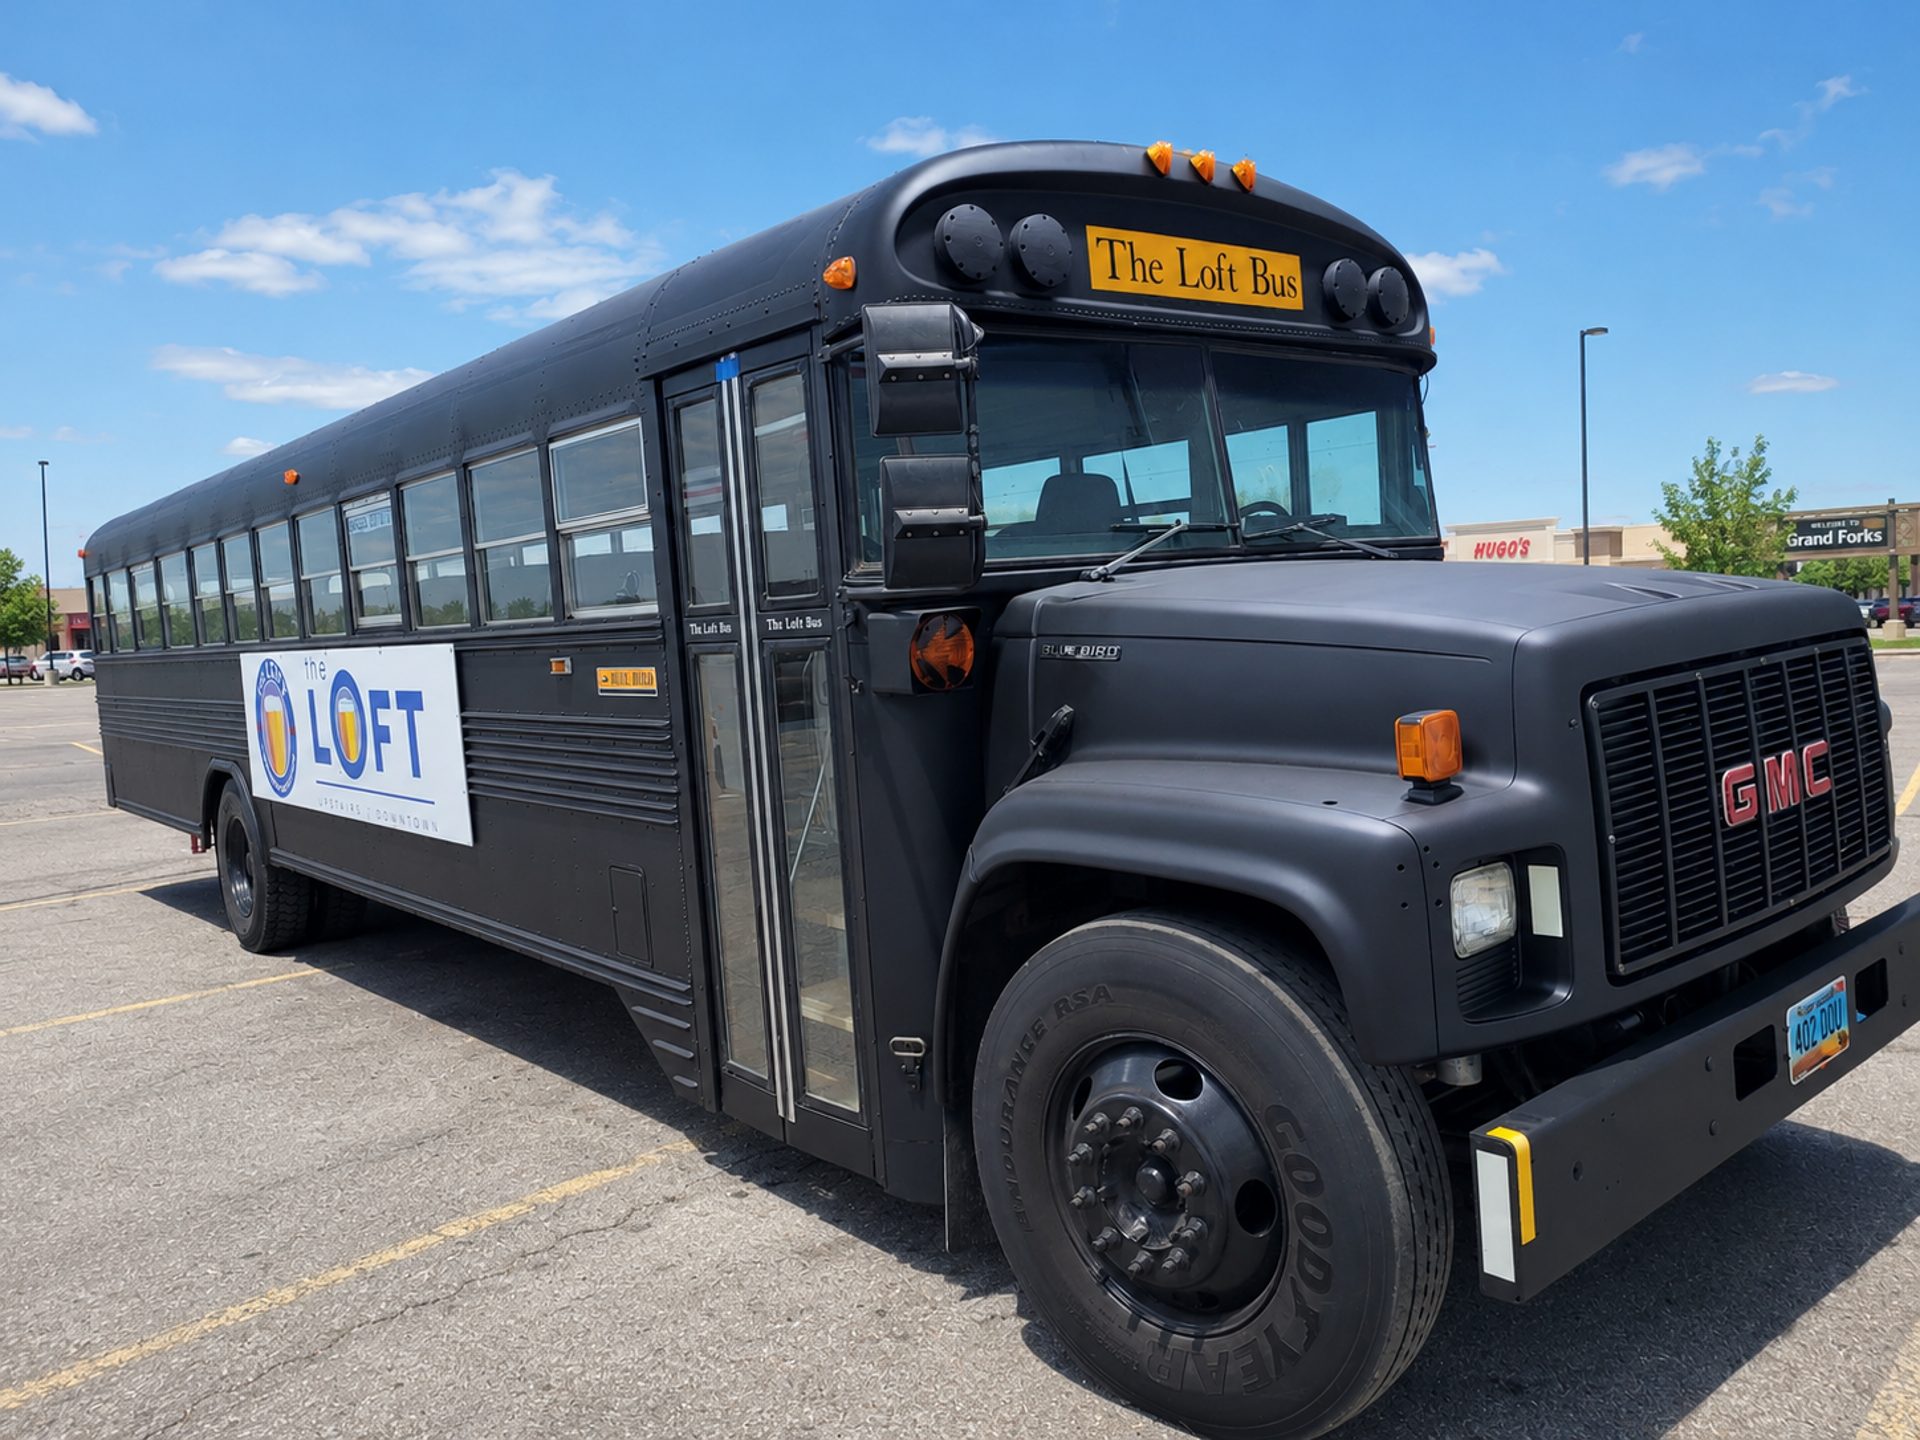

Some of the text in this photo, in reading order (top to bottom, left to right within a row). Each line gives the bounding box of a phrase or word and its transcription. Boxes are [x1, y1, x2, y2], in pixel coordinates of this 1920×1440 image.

[1096, 237, 1298, 299] The Loft Bus
[1474, 537, 1531, 559] HUGO'S
[1786, 528, 1882, 547] Grand Forks
[304, 657, 327, 681] the
[307, 668, 424, 780] LOFT
[1722, 739, 1831, 827] GMC
[375, 808, 439, 833] DOWNTOWN
[1796, 1015, 1818, 1055] 402
[1000, 984, 1114, 1233] ENDURANCE RSA
[1146, 1103, 1334, 1396] GOODYEAR
